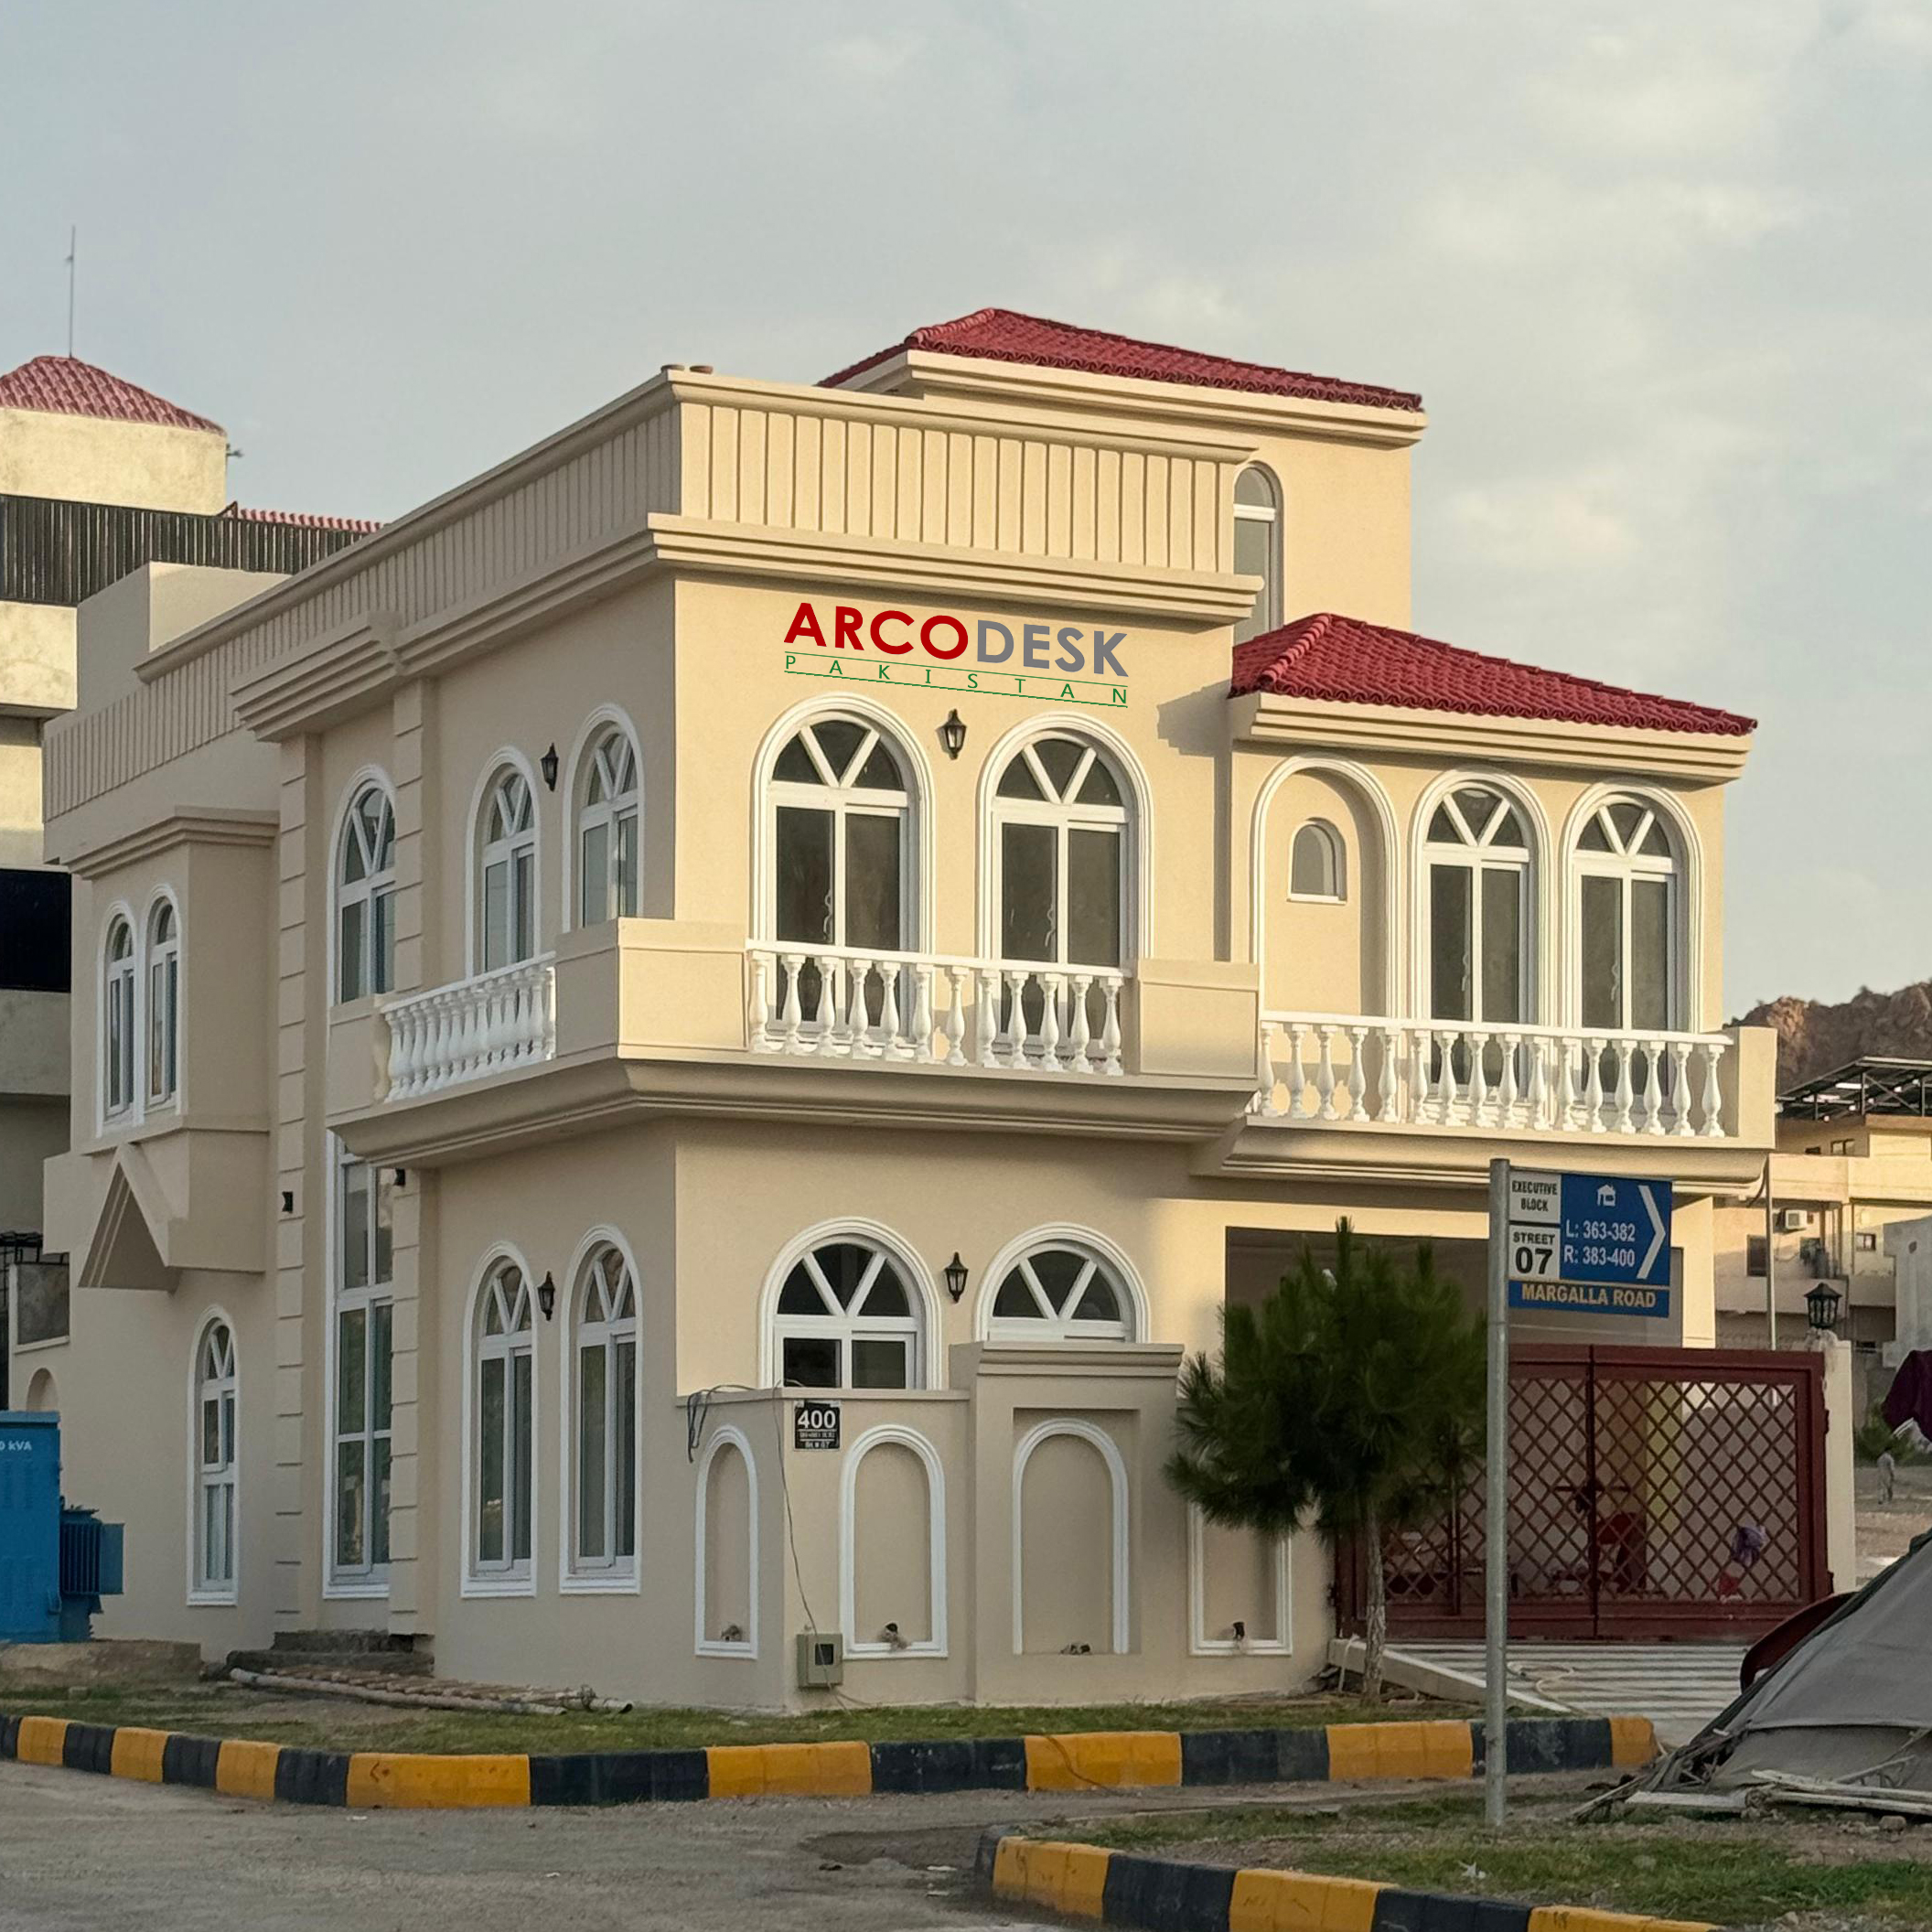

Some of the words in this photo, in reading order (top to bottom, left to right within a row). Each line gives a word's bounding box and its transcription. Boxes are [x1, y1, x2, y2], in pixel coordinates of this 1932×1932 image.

[1512, 1180, 1558, 1195] EXECUTIVE
[1520, 1197, 1549, 1211] BLOCK
[1513, 1231, 1555, 1245] STREET
[1565, 1219, 1579, 1238] L:
[1583, 1220, 1636, 1242] 363-382
[1515, 1247, 1553, 1275] 07
[1564, 1244, 1579, 1263] R:
[1583, 1248, 1636, 1267] 383-400
[1521, 1283, 1609, 1305] MARGALLA
[1613, 1289, 1657, 1308] ROAD
[798, 1410, 836, 1429] 400
